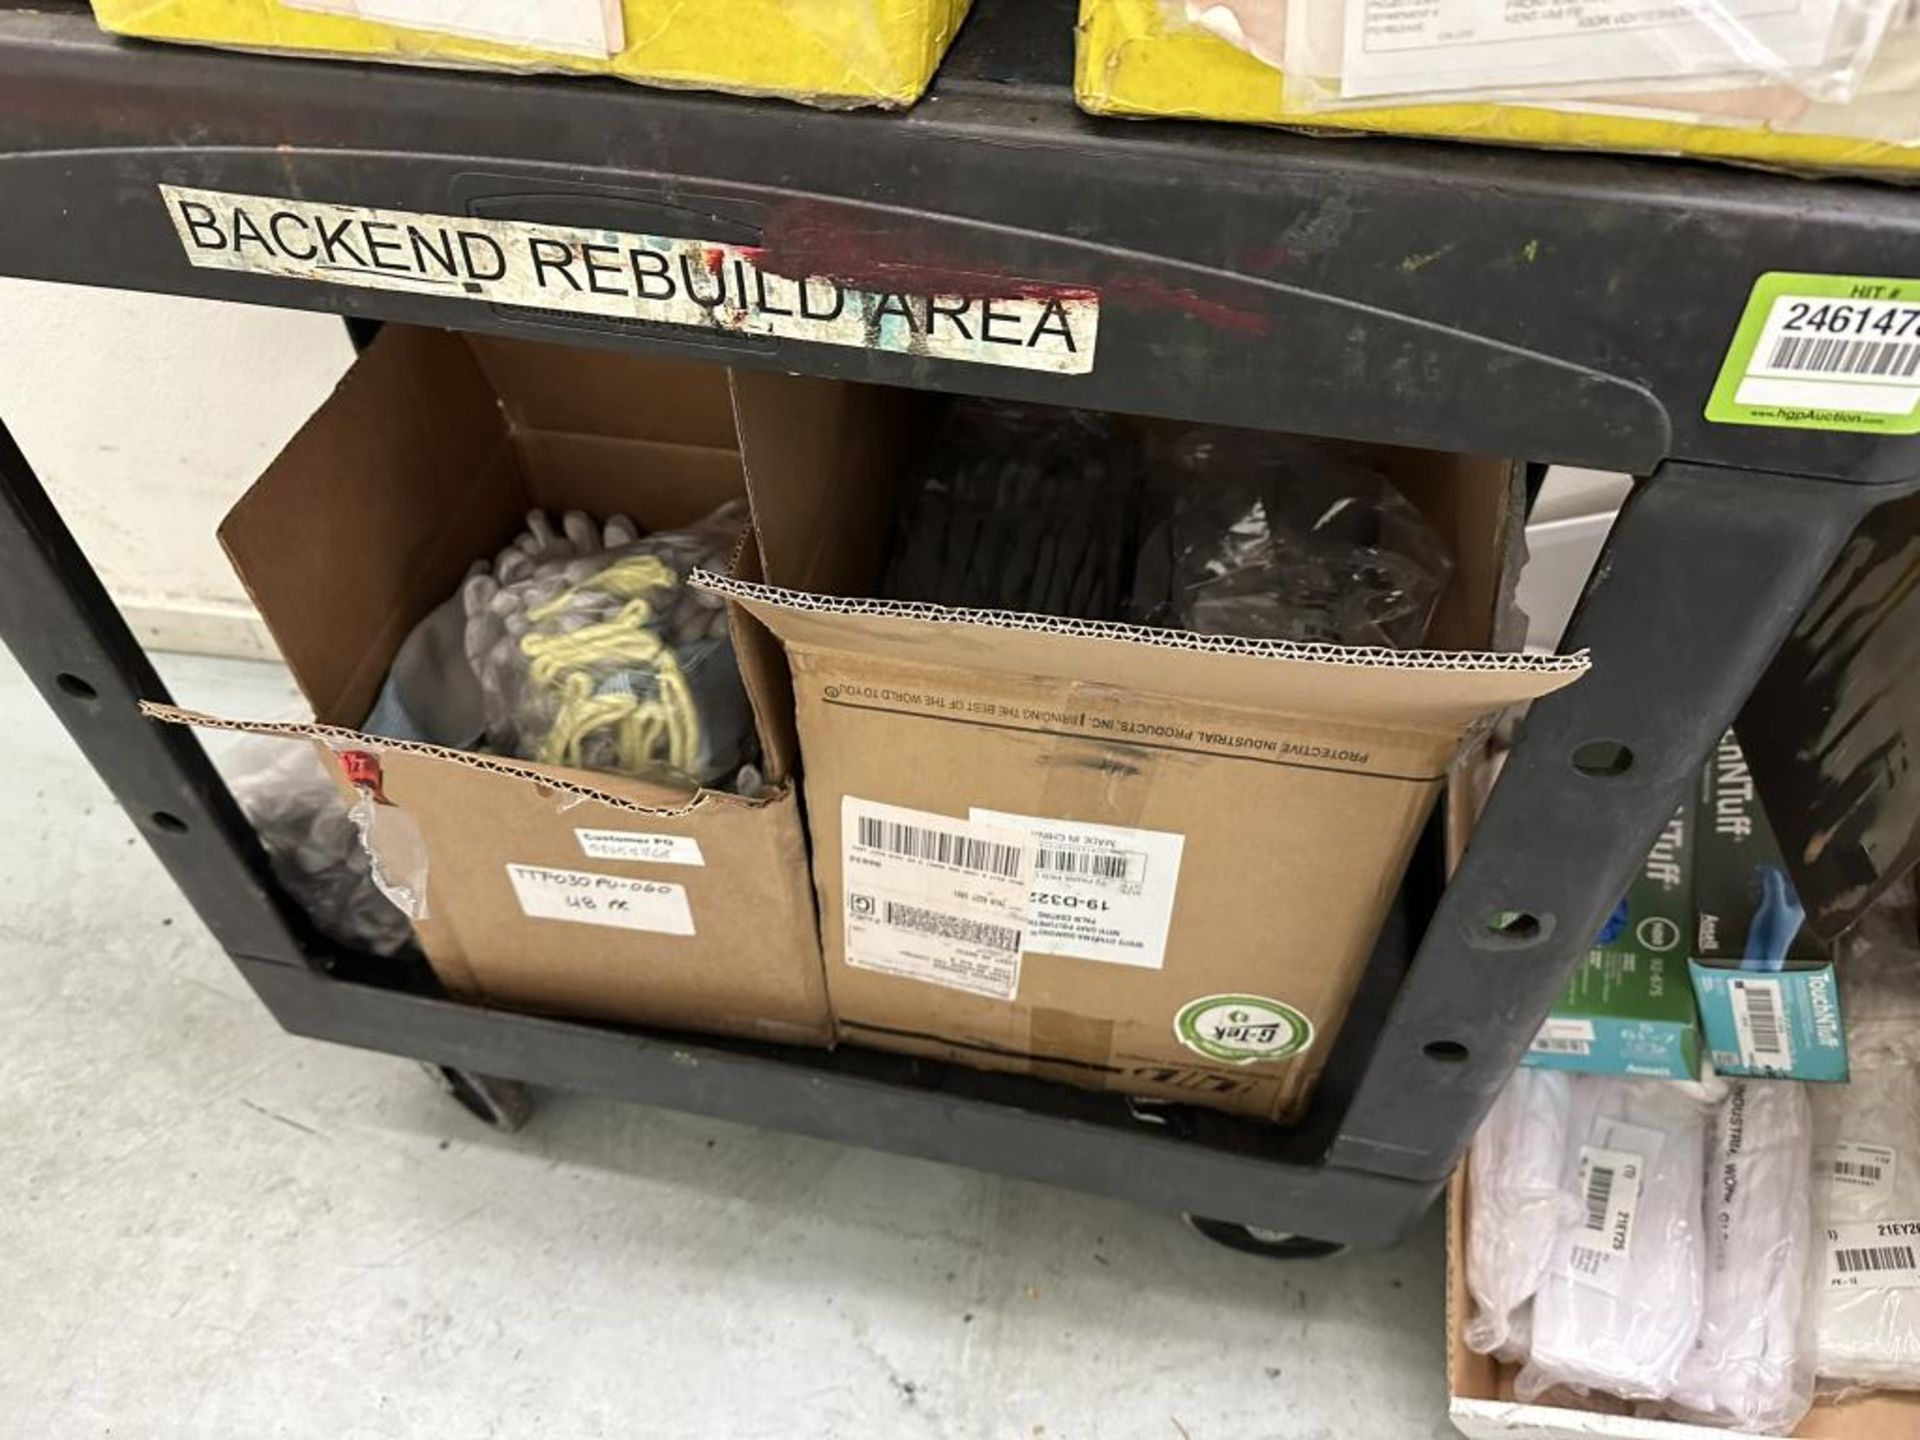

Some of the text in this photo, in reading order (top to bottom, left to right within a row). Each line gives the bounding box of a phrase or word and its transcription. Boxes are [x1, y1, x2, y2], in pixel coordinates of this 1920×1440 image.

[178, 200, 507, 281] BACKEND
[529, 236, 843, 321] REBUILD
[872, 293, 1078, 353] AREA
[1851, 284, 1903, 299] HIT #
[1750, 408, 1885, 424] www.hgpAuction.com
[863, 687, 879, 698] TO
[882, 689, 923, 706] WORLD
[923, 695, 946, 709] THE
[948, 699, 965, 711] OF
[967, 701, 996, 716] BEST
[998, 705, 1020, 719] THE
[1199, 731, 1277, 751] INDUSTRIAL
[1281, 743, 1369, 764] PROTECTIVE
[583, 832, 650, 845] Customer
[1807, 972, 1840, 1048] TouchNTuff
[1214, 1025, 1277, 1043] G-Tek
